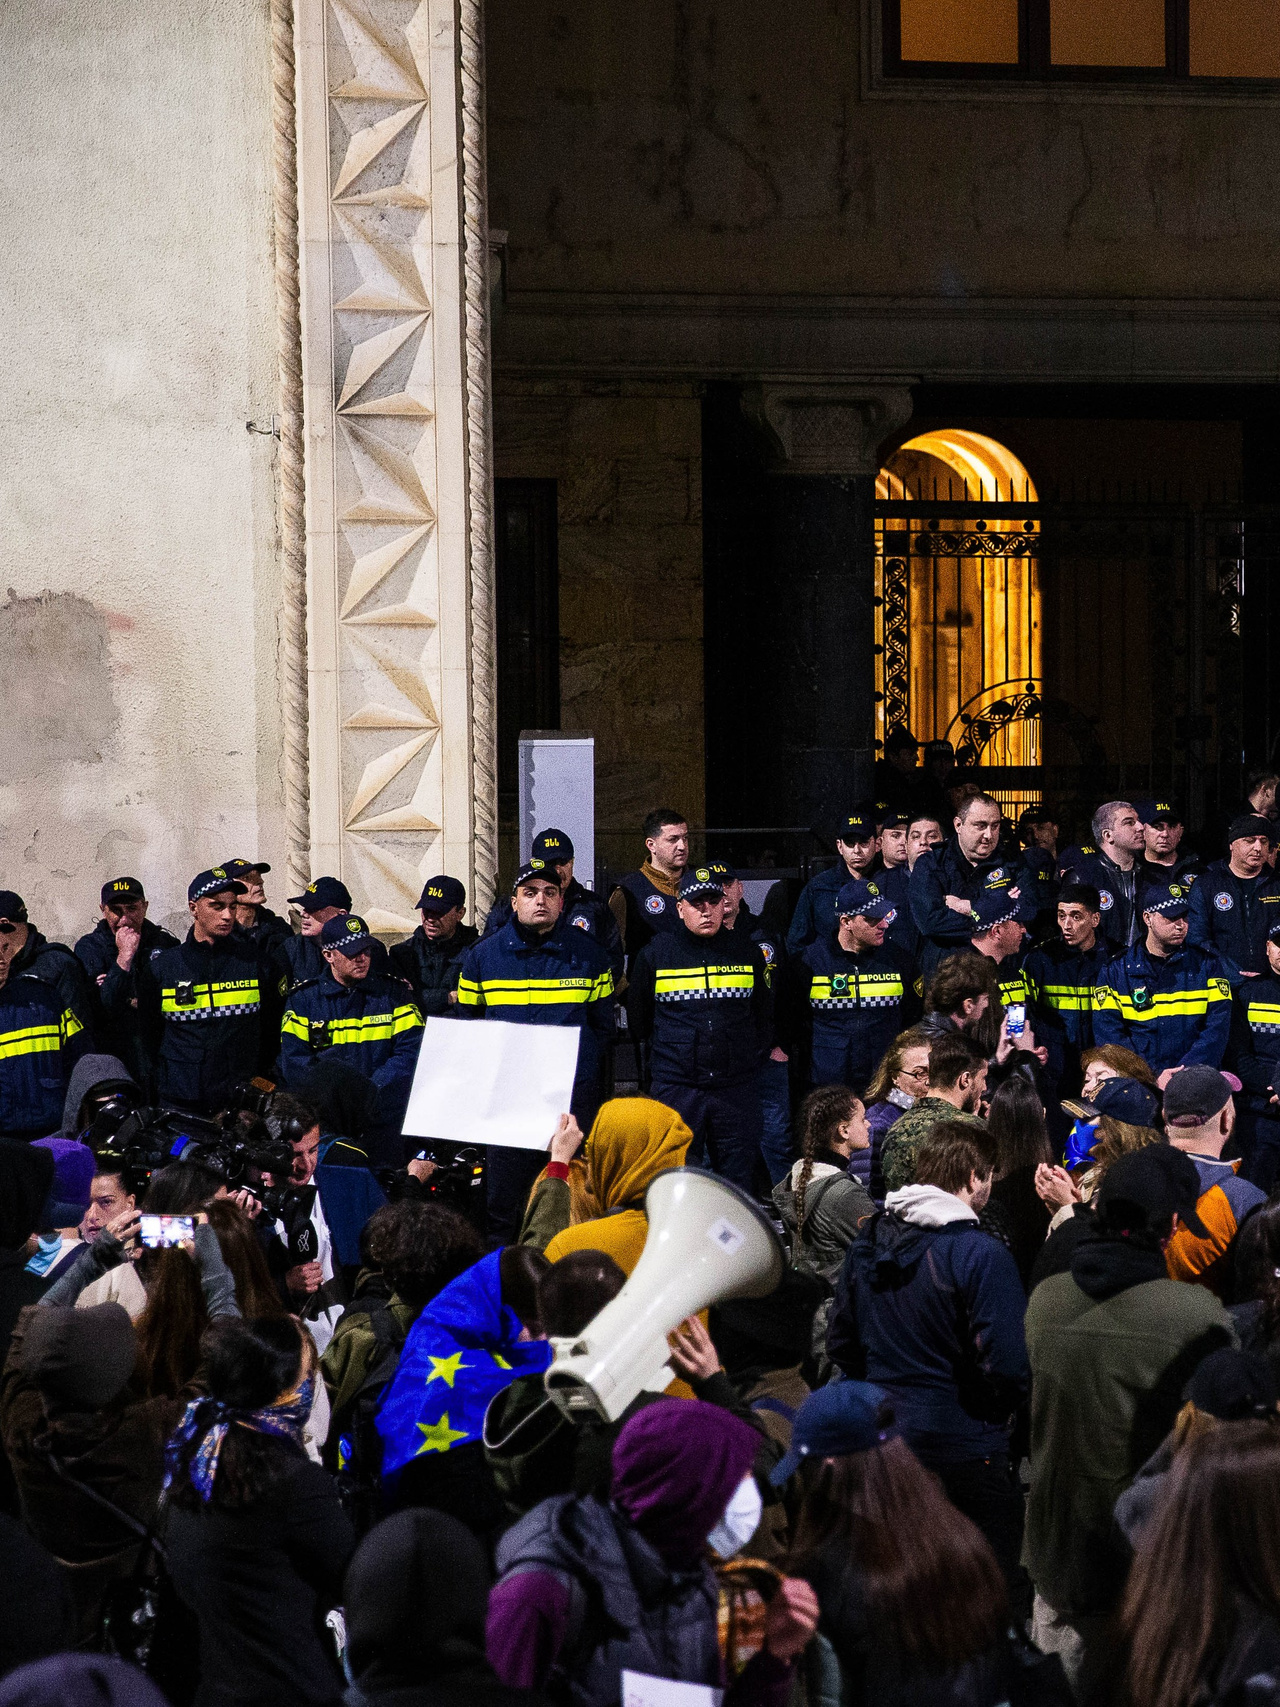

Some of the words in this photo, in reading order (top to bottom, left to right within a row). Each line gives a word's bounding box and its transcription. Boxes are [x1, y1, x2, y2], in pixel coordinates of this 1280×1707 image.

[1156, 803, 1170, 811] შსს
[848, 816, 863, 825] შსს
[544, 838, 560, 848] შსს
[113, 881, 130, 891] შსს
[428, 886, 444, 898] შსს
[717, 966, 744, 974] POLICE
[868, 973, 897, 982] POLICE
[220, 981, 249, 990] POLICE
[559, 979, 586, 987] POLICE
[369, 1015, 391, 1024] POLIC
